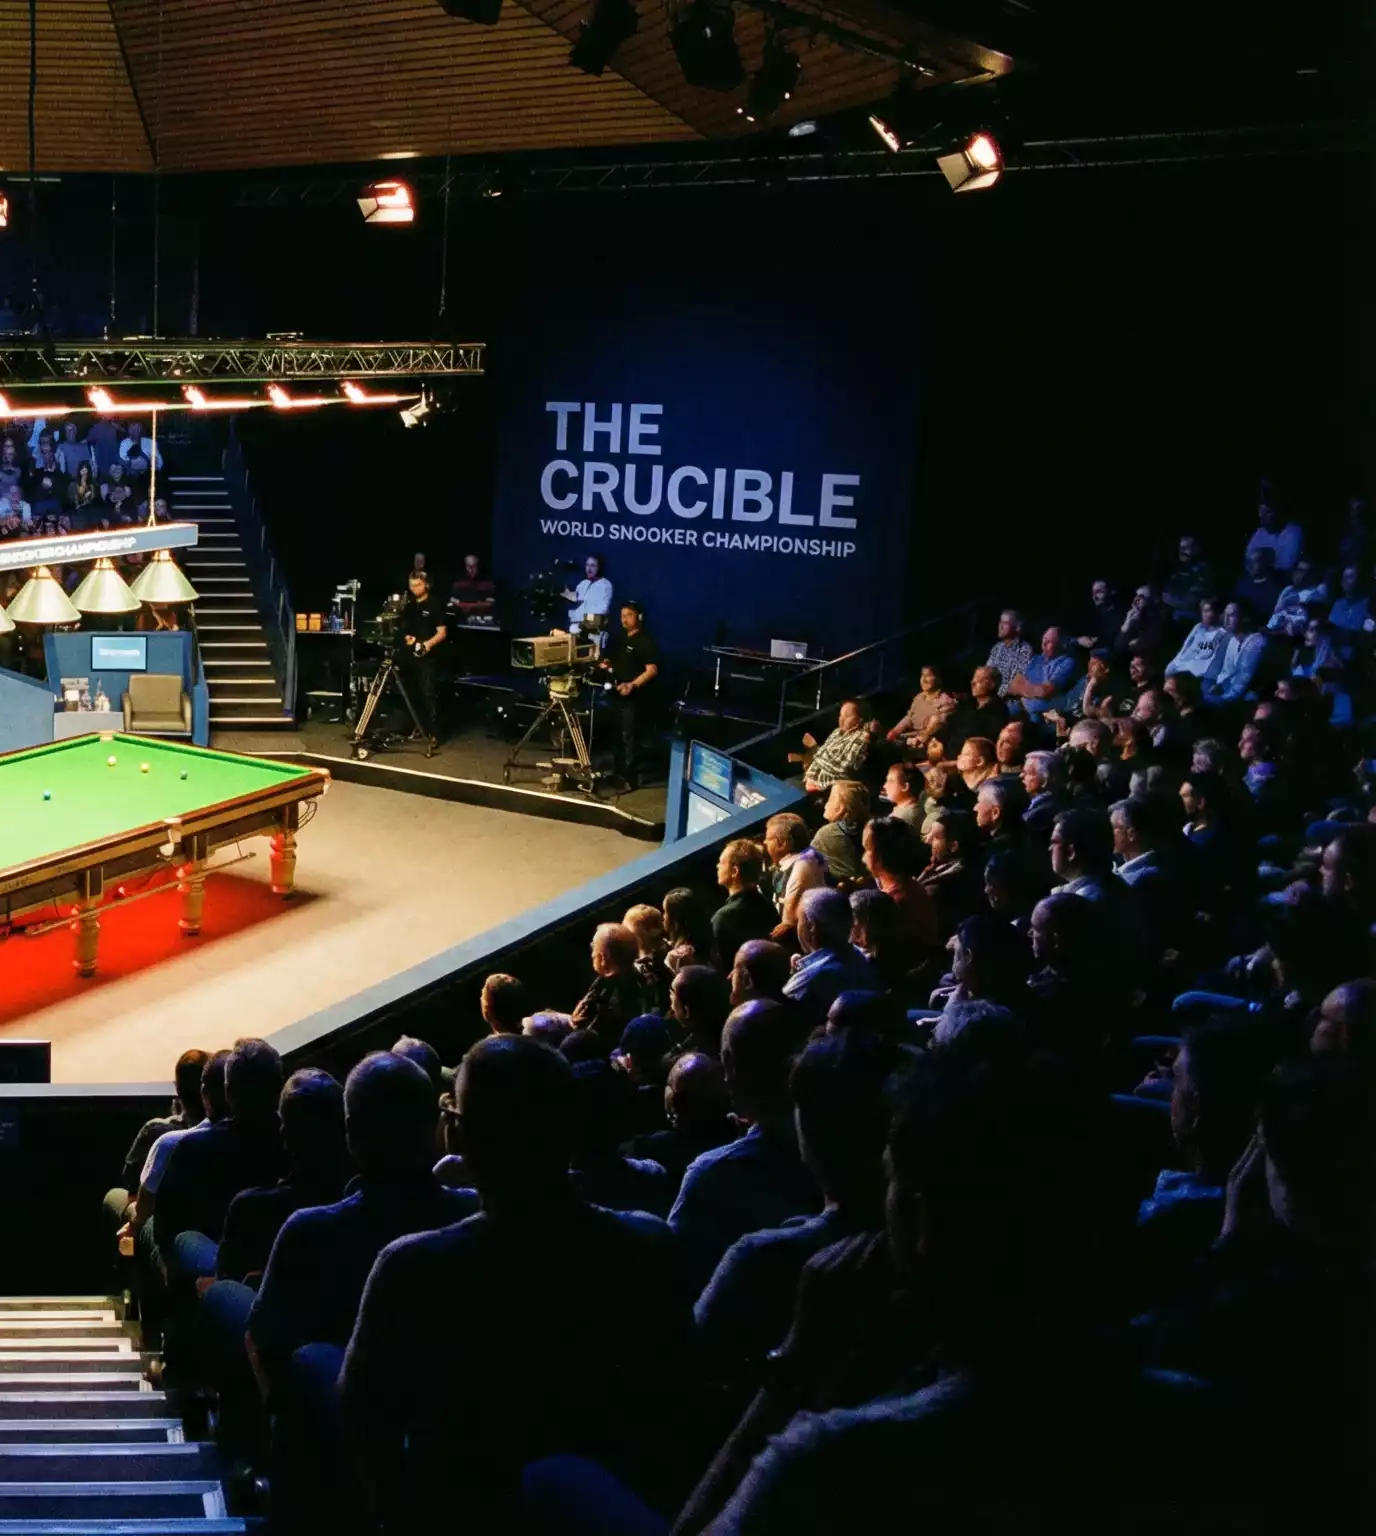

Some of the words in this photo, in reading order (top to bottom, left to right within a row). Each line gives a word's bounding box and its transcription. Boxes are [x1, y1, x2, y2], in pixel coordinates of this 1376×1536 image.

[545, 401, 664, 456] THE
[540, 459, 860, 529] CRUCIBLE
[540, 519, 605, 539] WORLD
[608, 523, 698, 547] SNOOKER
[702, 531, 856, 558] CHAMPIONSHIP
